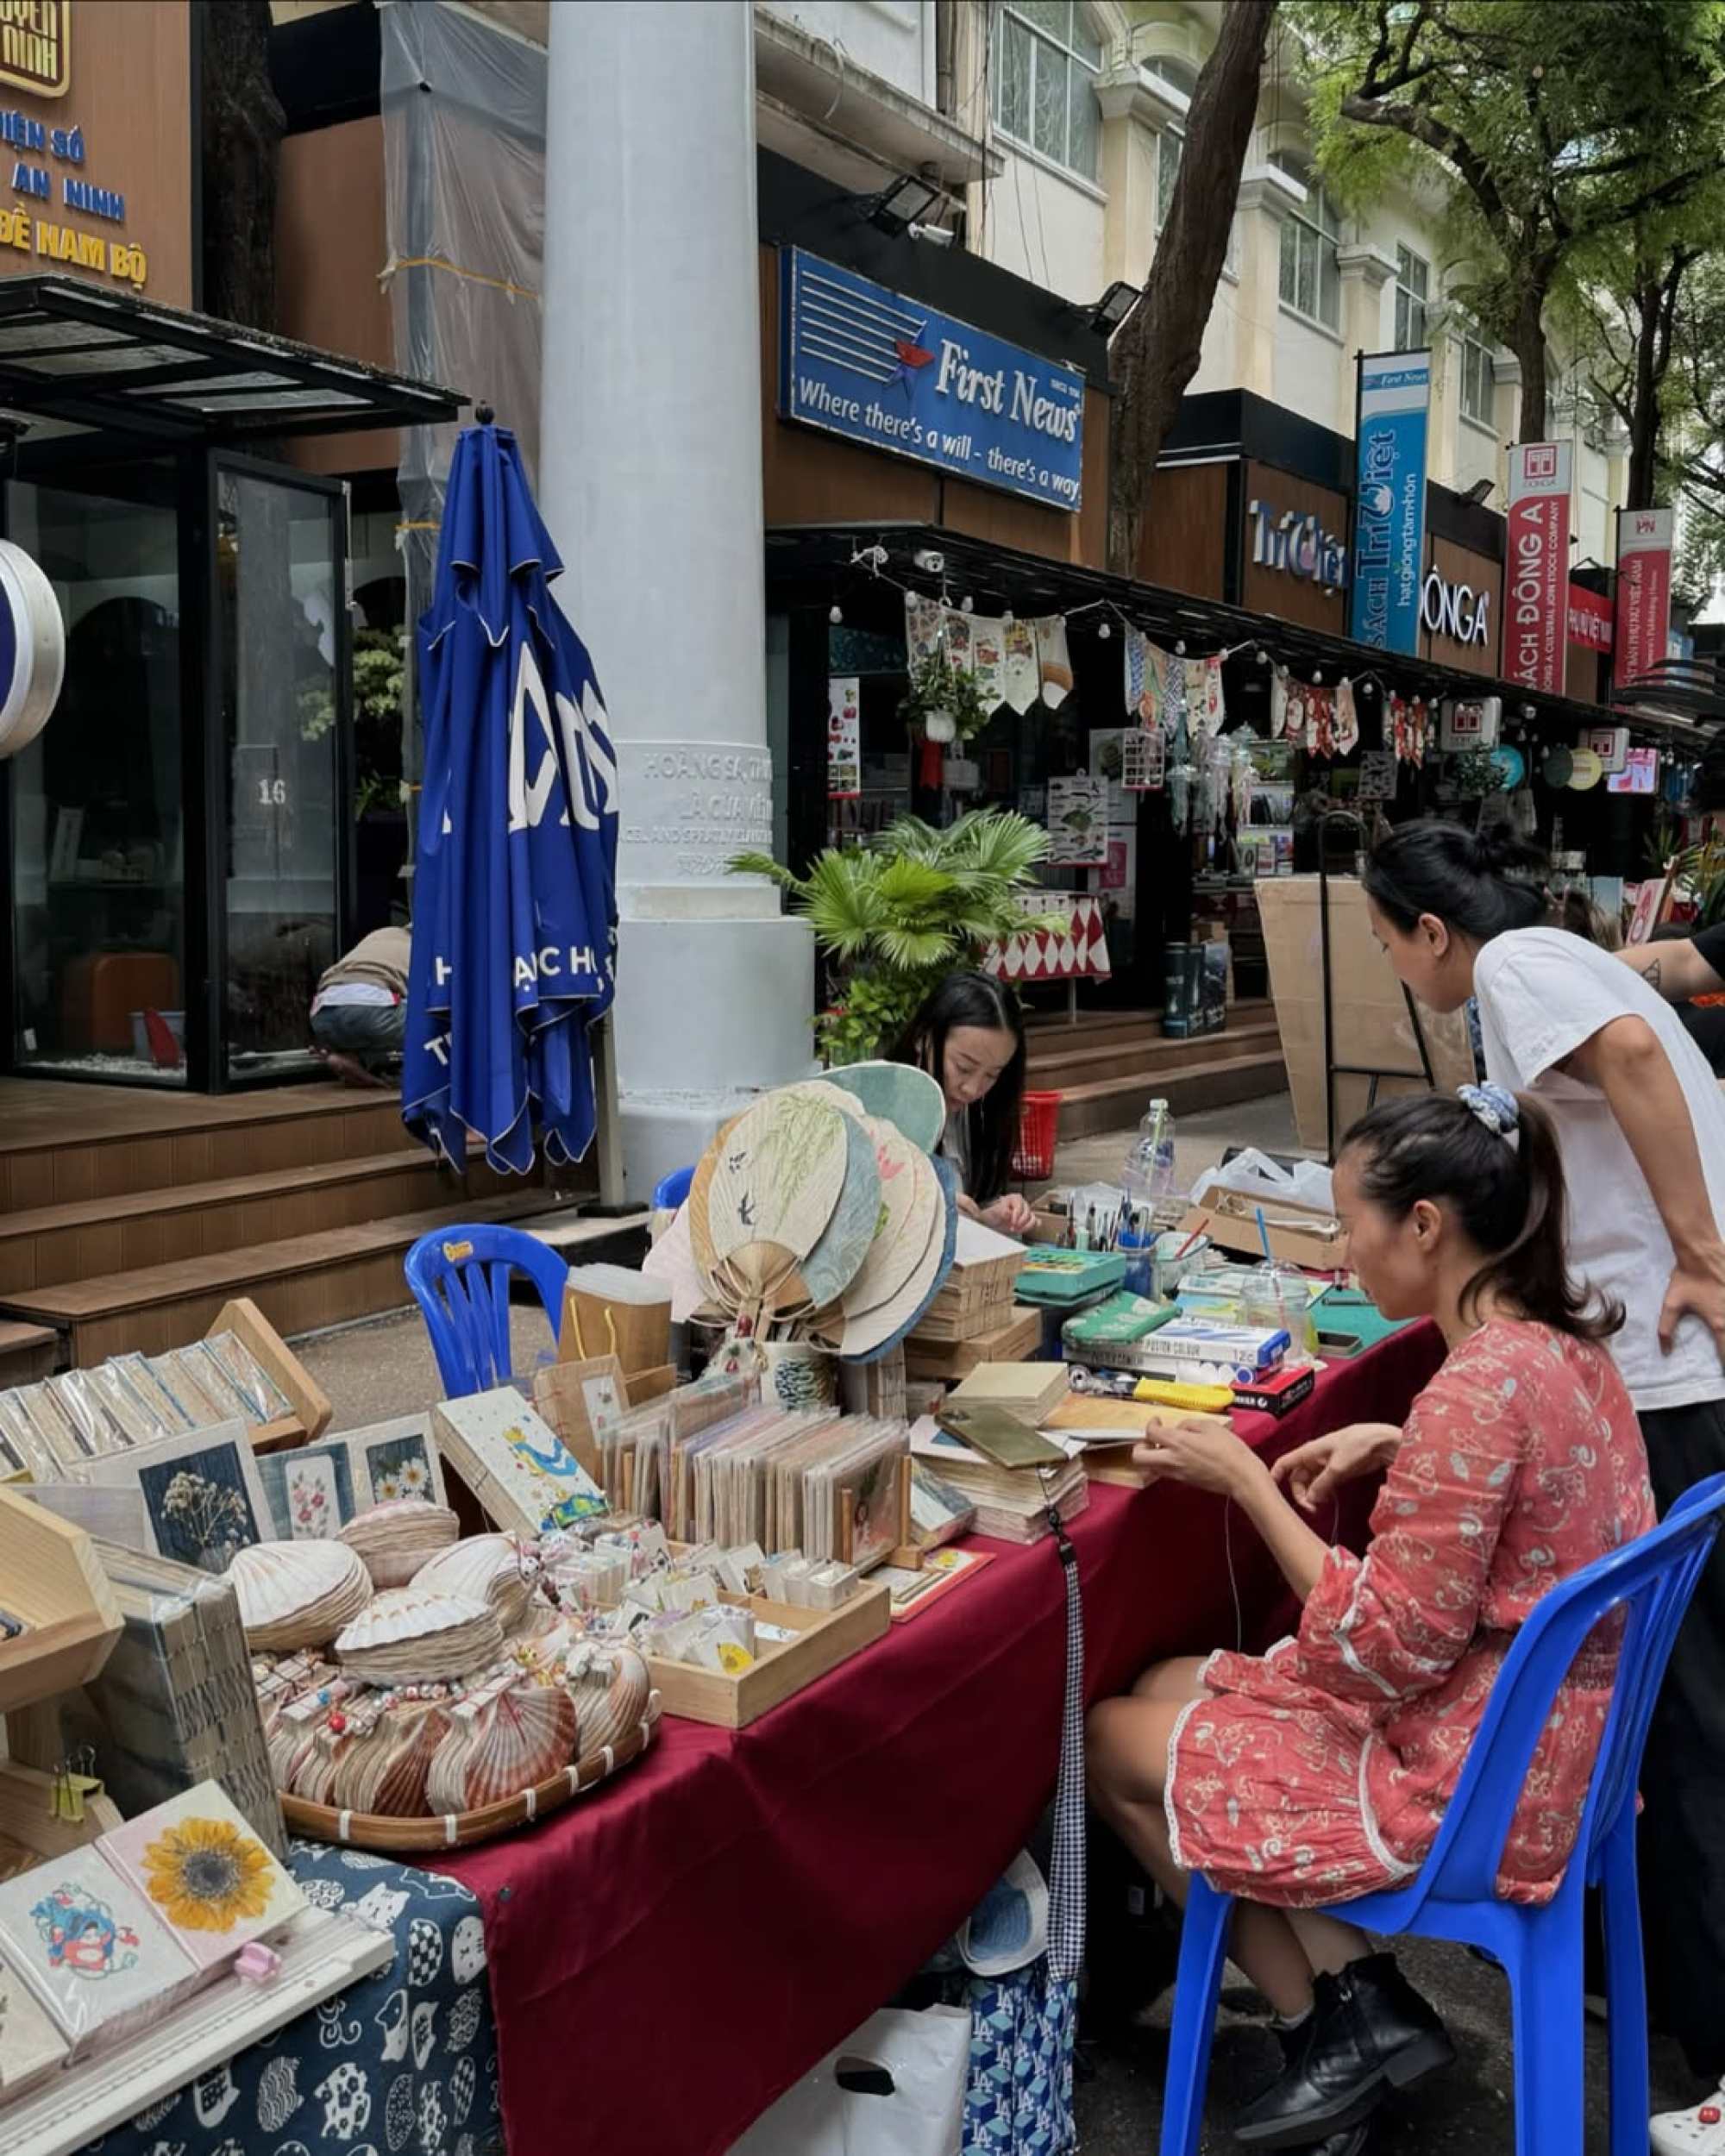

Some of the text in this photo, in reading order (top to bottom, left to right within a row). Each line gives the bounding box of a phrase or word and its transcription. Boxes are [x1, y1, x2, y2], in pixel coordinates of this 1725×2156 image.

[50, 124, 85, 163] SỐ
[11, 160, 125, 222] AN NINH
[36, 220, 106, 271] NAM
[110, 241, 147, 290] BỘ
[934, 338, 1078, 443] First News
[799, 376, 860, 423] Where
[864, 402, 923, 444] there's
[925, 430, 938, 449] a
[942, 433, 972, 461] will
[987, 446, 1036, 484] there's
[1038, 470, 1050, 488] a
[1051, 473, 1080, 503] way
[1520, 502, 1544, 525] A
[1511, 532, 1543, 625] ĐÔNG
[259, 779, 285, 805] 16
[971, 2118, 992, 2148] LA
